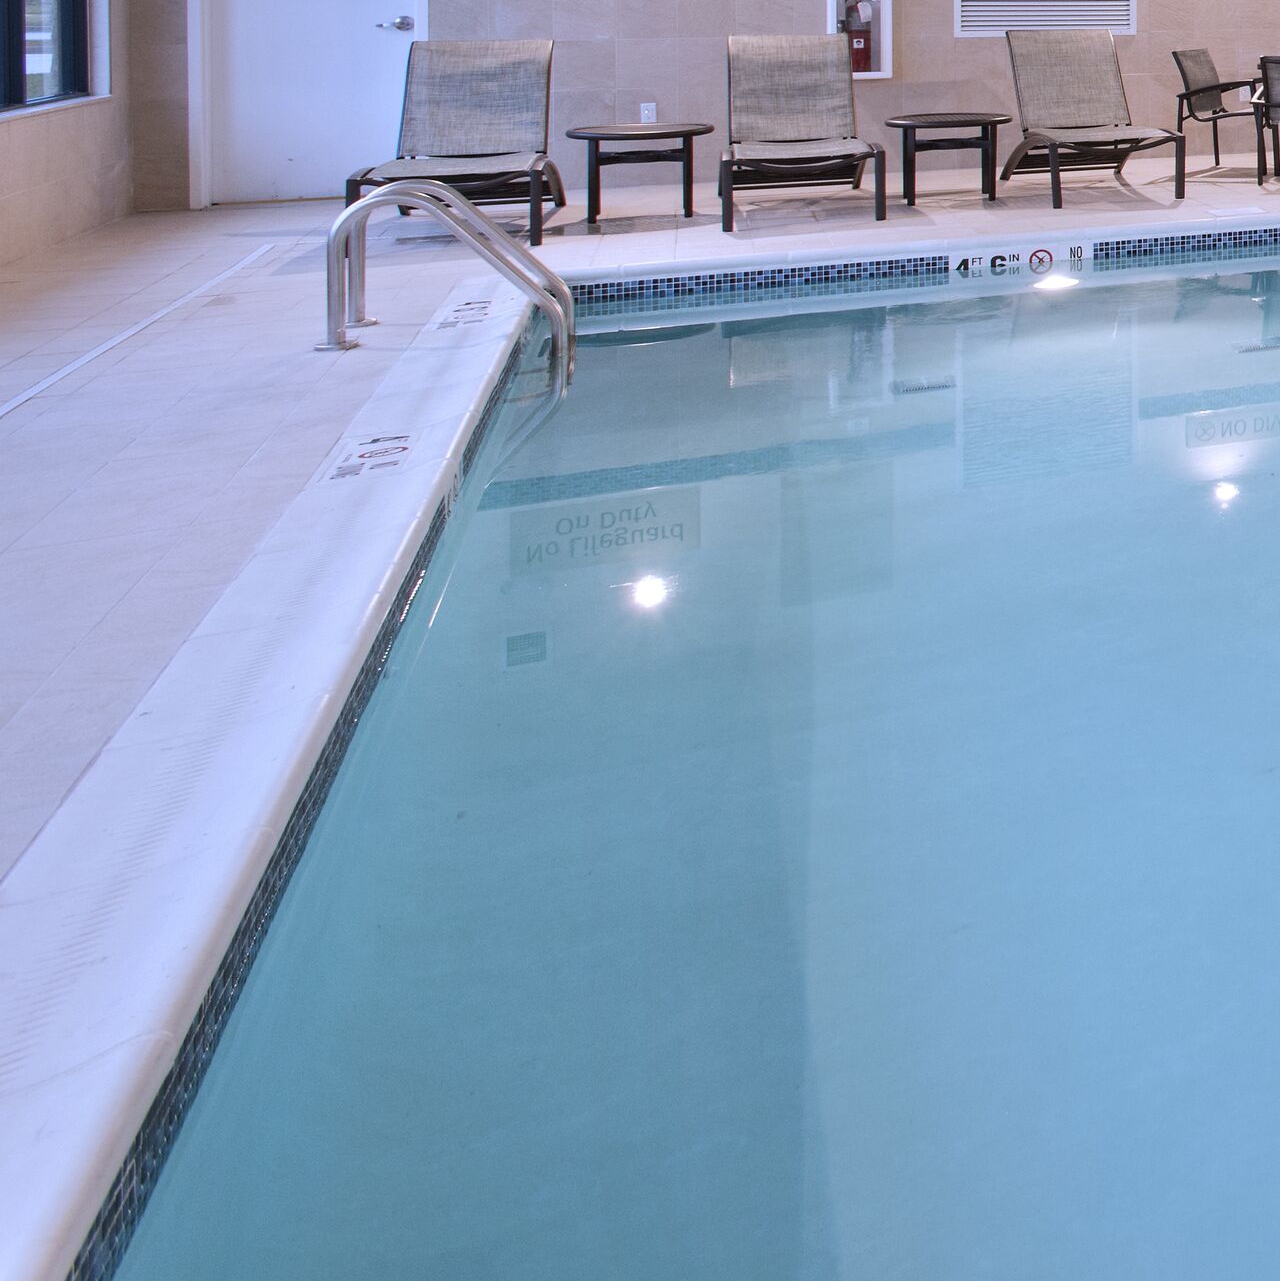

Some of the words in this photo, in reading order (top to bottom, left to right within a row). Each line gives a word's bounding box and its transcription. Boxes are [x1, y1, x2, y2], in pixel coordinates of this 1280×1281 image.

[971, 257, 983, 267] FT
[1008, 253, 1020, 263] IN
[1069, 246, 1083, 259] NO
